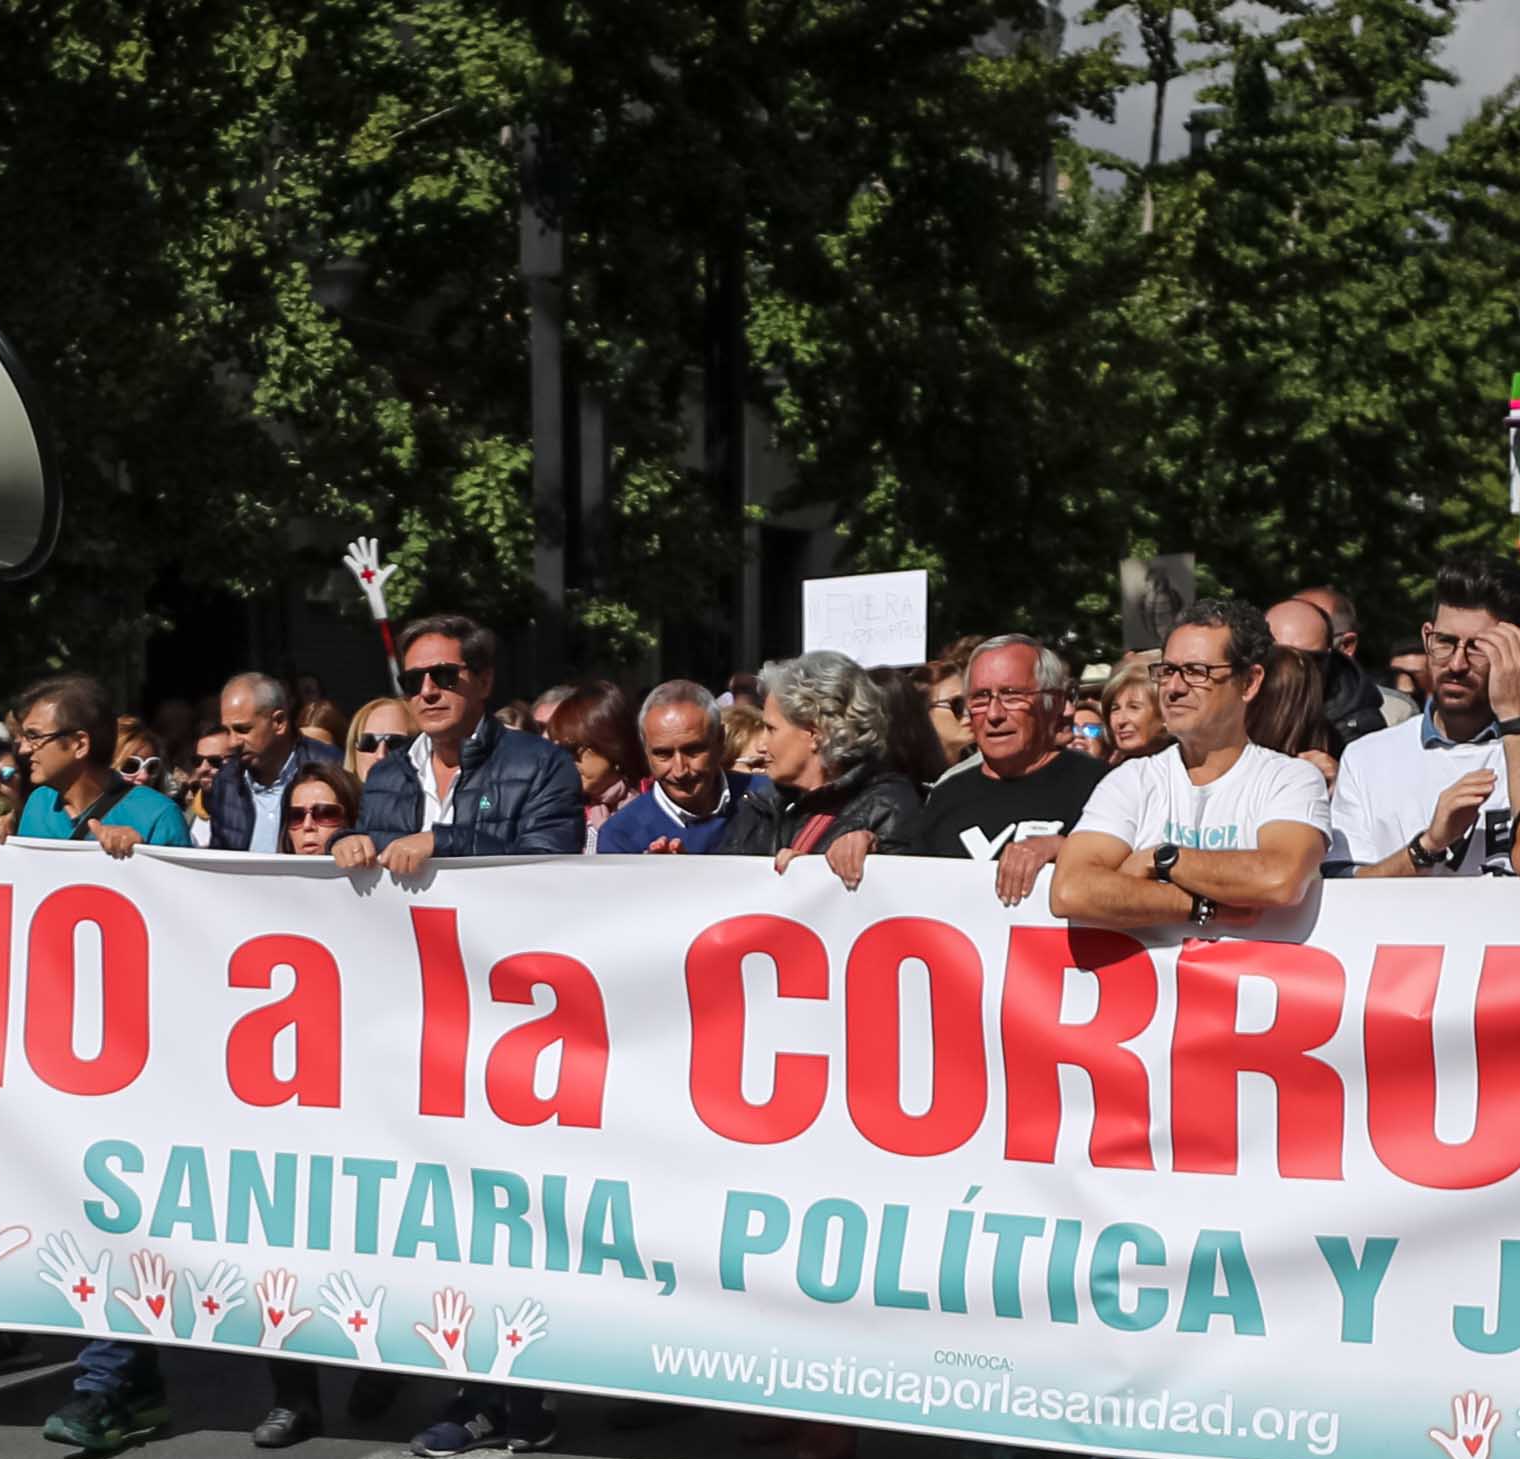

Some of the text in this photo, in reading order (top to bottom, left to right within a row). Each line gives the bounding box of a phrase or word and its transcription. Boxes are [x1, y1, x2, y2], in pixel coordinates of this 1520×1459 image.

[226, 932, 342, 1109] a
[409, 905, 610, 1130] la
[83, 1140, 677, 1296] SANITARIA,
[719, 1185, 1265, 1335] POLÍTICA
[1316, 1237, 1399, 1344] Y
[650, 1343, 1341, 1456] www.justiciaporlasanidad.org
[934, 1350, 1015, 1372] CONVOCA:
